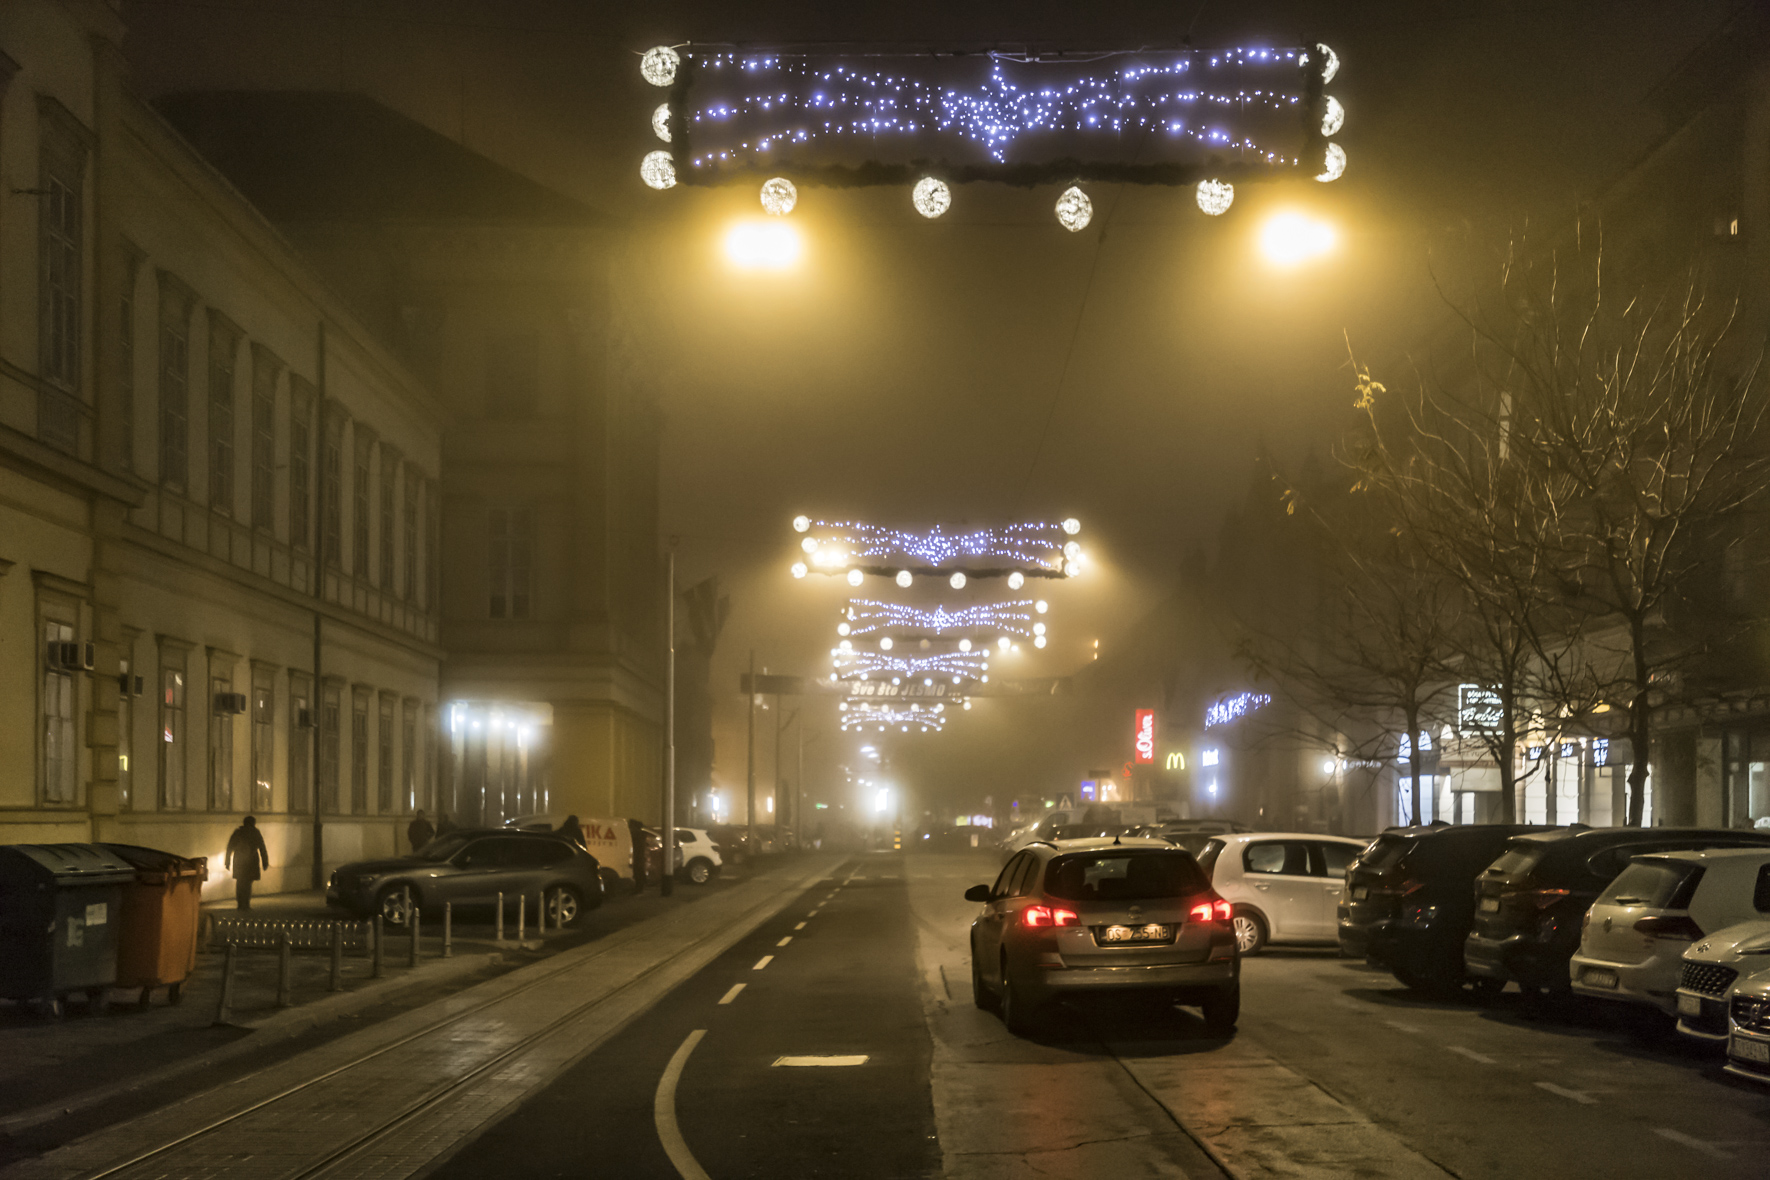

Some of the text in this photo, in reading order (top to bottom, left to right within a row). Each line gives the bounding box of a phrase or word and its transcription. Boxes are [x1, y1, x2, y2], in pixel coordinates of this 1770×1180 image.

[851, 682, 875, 695] Sve
[877, 682, 899, 696] što
[901, 685, 945, 696] JESMO
[1136, 714, 1153, 759] s.Oliver
